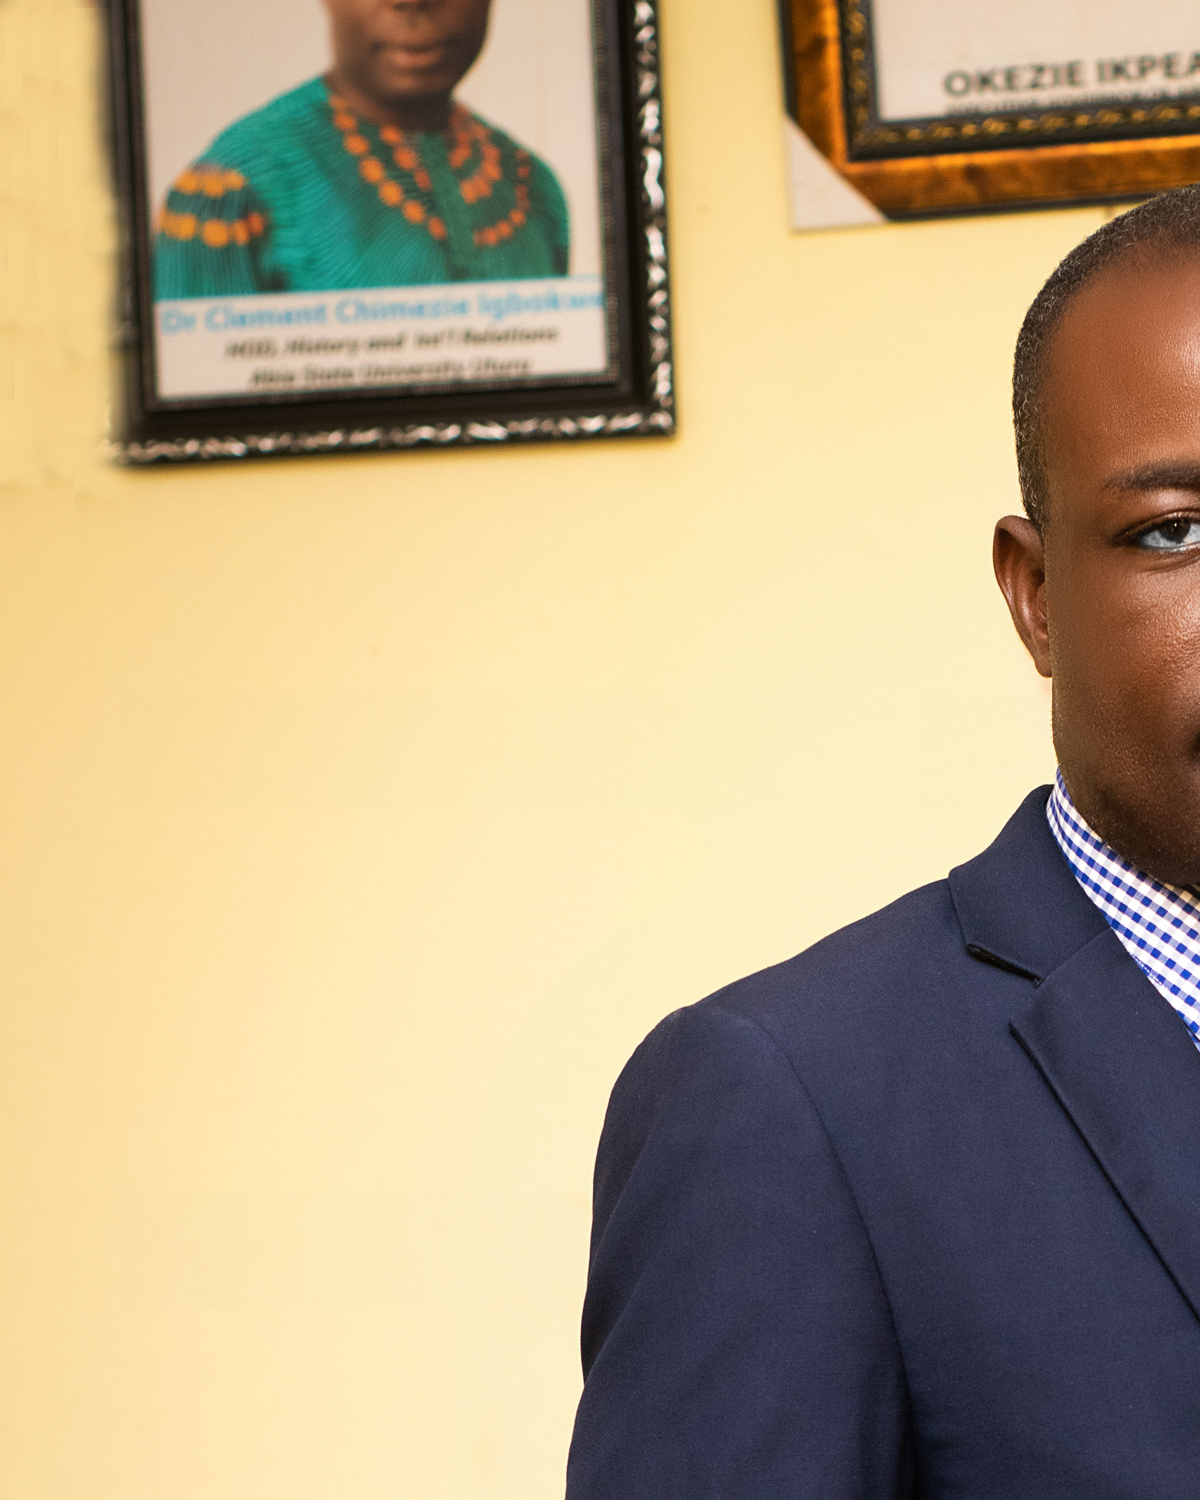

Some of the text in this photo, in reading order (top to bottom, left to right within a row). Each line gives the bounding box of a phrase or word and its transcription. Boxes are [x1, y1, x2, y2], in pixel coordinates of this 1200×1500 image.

[944, 60, 1083, 96] OKEZIE
[161, 308, 196, 335] Dr
[205, 303, 327, 331] Clement
[286, 334, 359, 355] History
